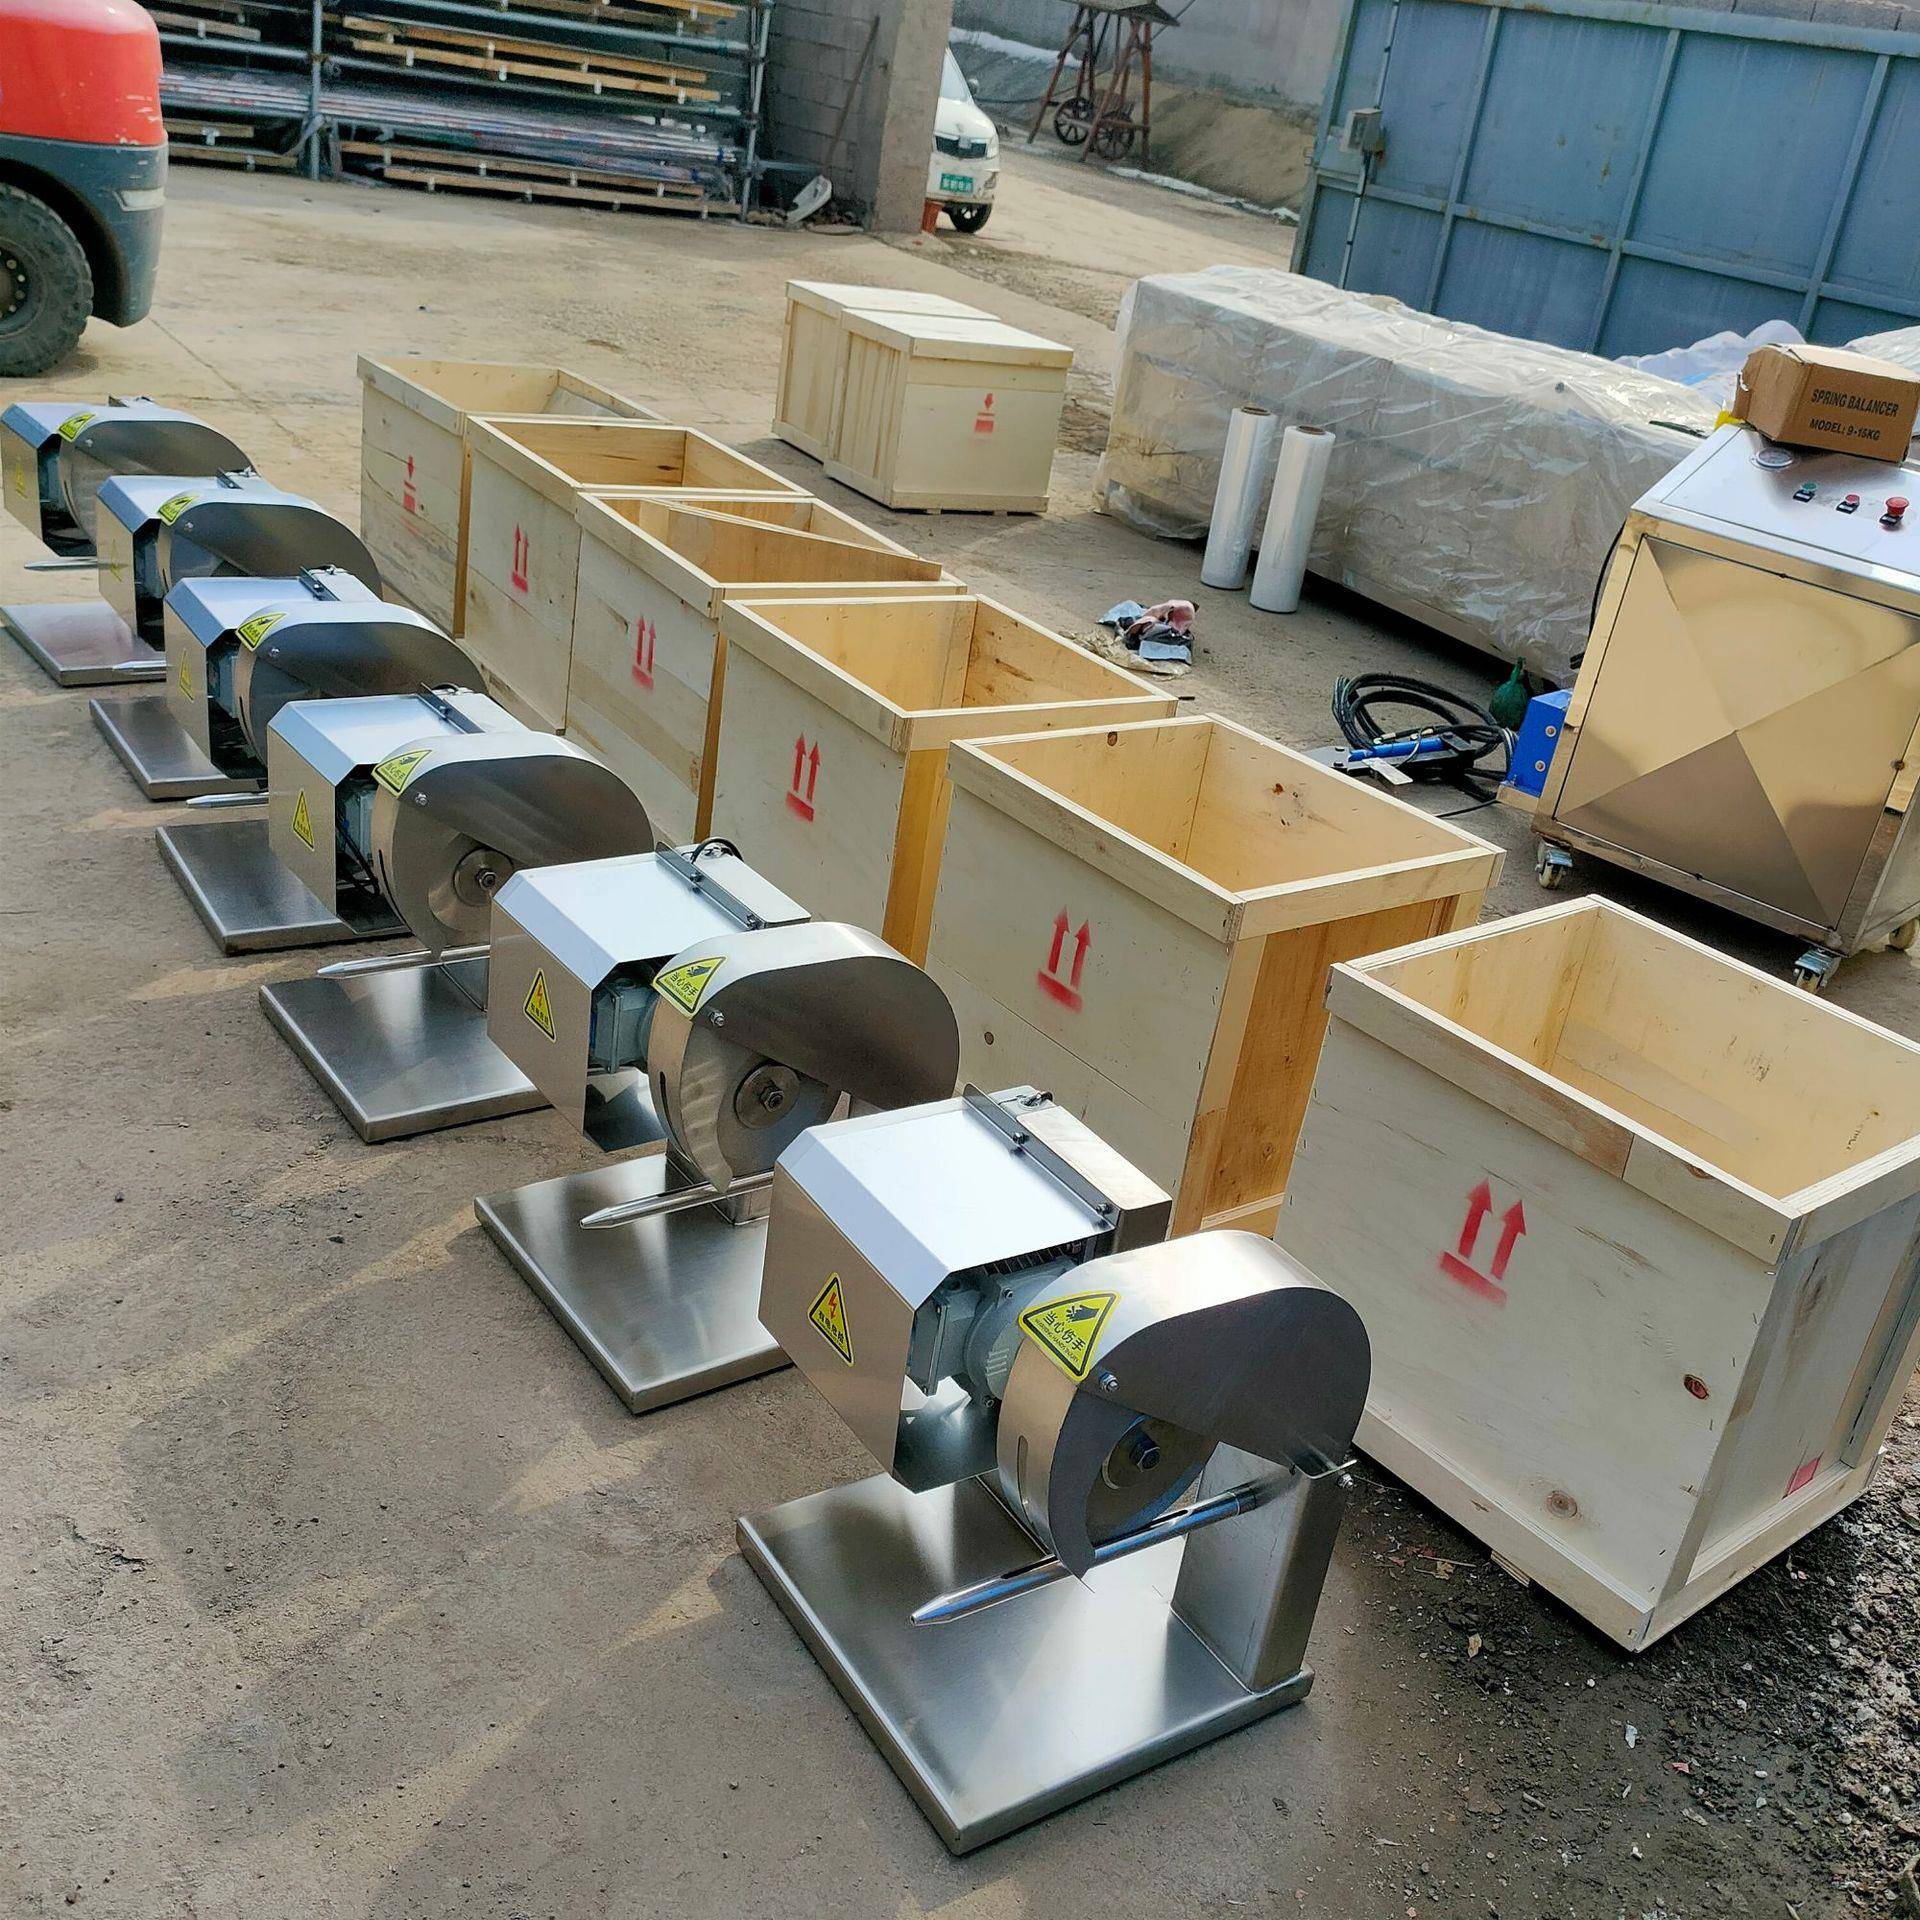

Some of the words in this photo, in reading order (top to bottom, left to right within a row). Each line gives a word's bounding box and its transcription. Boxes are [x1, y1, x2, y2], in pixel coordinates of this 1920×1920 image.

[1811, 388, 1848, 408] SPRING
[1847, 395, 1899, 418] BALANCER
[1809, 418, 1846, 435] MODEL:
[1042, 1311, 1086, 1351] 当心伤手
